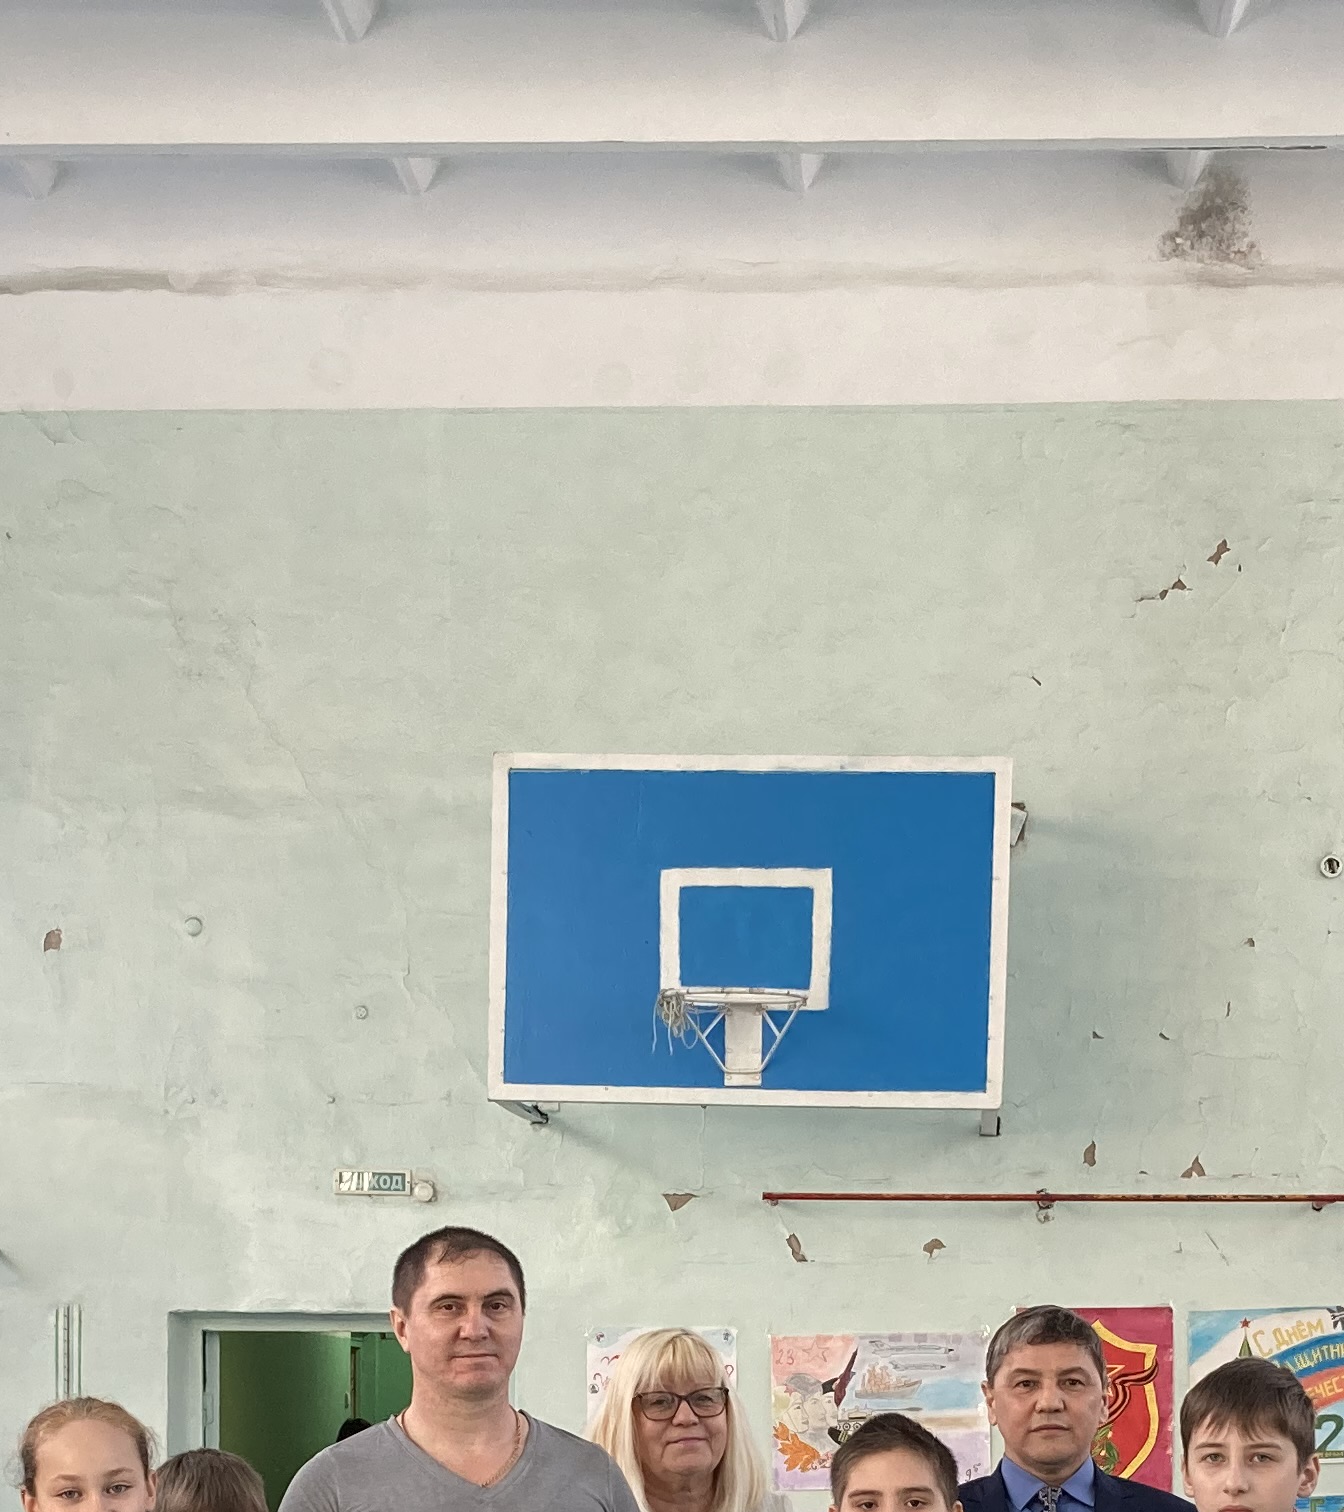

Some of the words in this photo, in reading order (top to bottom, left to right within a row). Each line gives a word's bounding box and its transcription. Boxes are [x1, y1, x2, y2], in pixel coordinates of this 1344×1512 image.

[351, 1174, 403, 1191] ХОД
[1251, 1329, 1271, 1357] С
[1272, 1318, 1325, 1348] ДНЁМ
